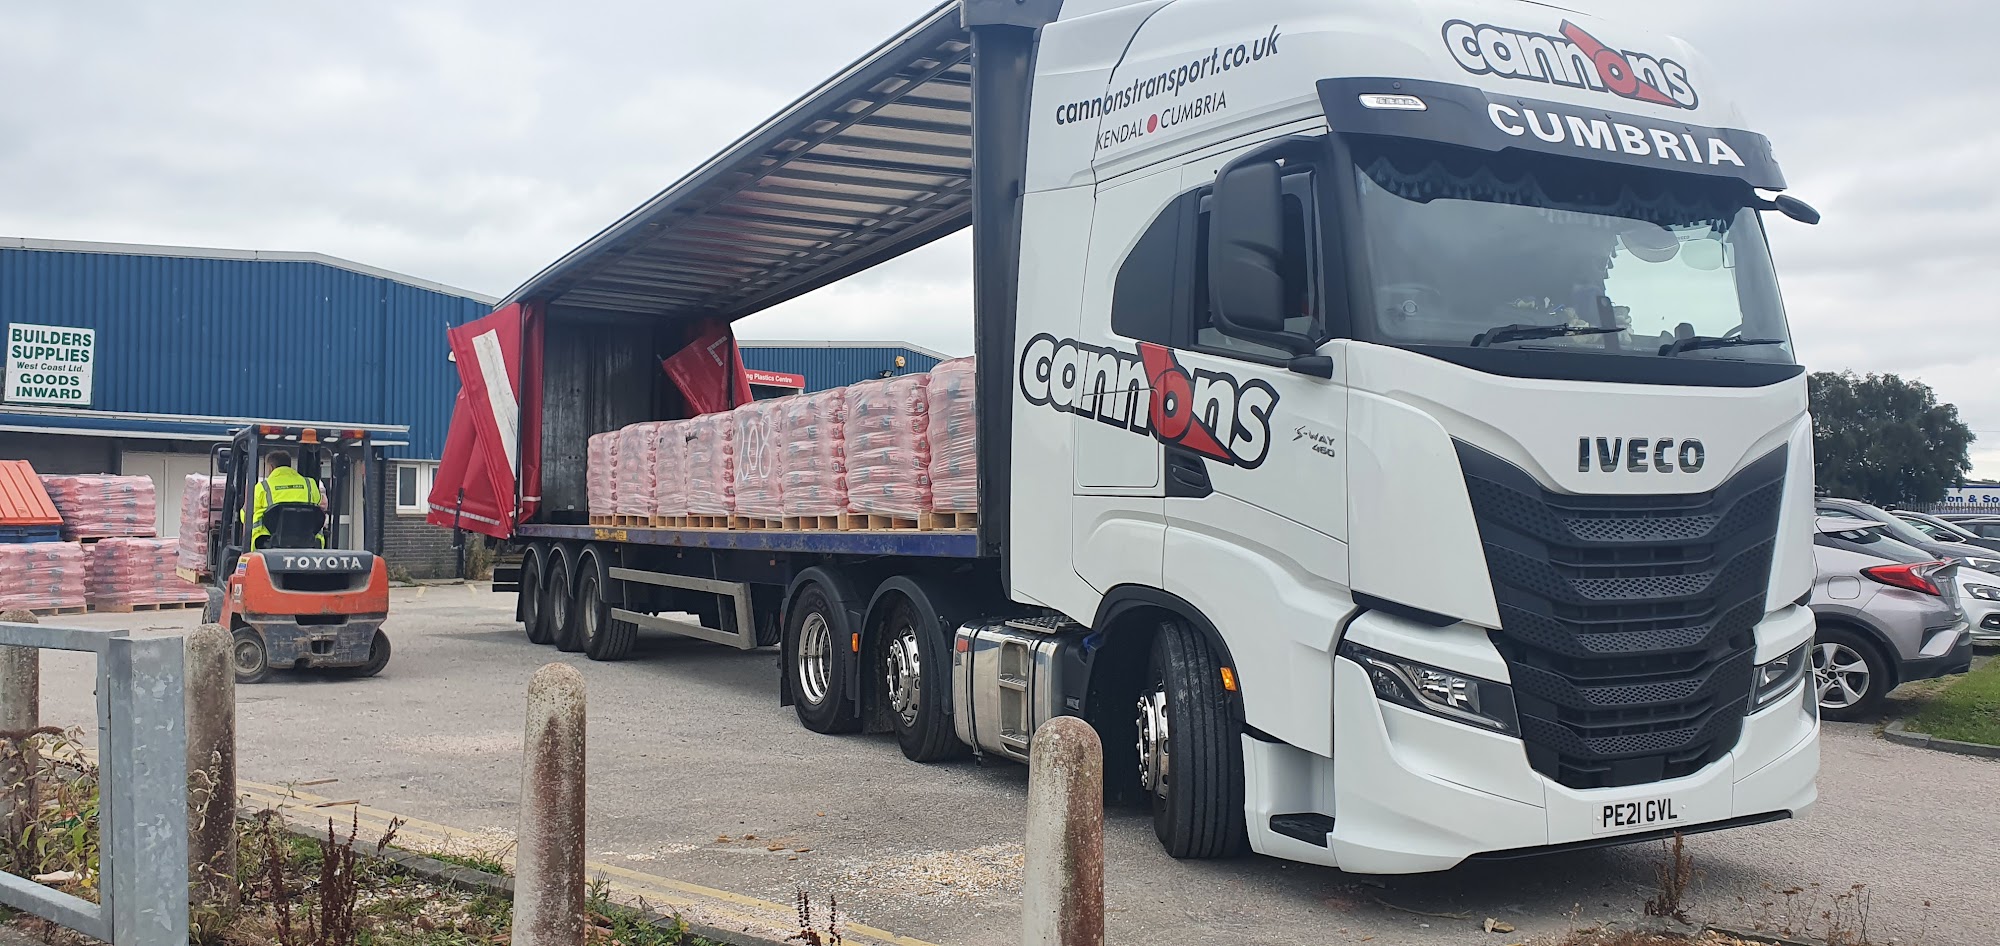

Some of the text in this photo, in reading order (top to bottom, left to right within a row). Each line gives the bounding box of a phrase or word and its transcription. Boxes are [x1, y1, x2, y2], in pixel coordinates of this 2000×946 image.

[1441, 19, 1699, 111] cannons
[1056, 24, 1282, 126] cannonstransport.co.uk
[1095, 90, 1227, 151] KENDAL CUMBRIA
[1487, 102, 1745, 167] CUMBRIA
[12, 328, 92, 347] BUILDERS
[11, 345, 90, 363] SUPPLIES
[16, 361, 84, 373] West Coast Ltd.
[19, 373, 80, 386] GOODS
[754, 373, 775, 382] Plastics
[775, 375, 792, 383] Centre
[15, 386, 82, 399] INWARD
[1019, 332, 1280, 470] cannons
[1292, 425, 1335, 446] S-WAY
[1311, 443, 1335, 458] 460
[1578, 436, 1705, 473] IVECO
[1968, 494, 1977, 503] &
[283, 556, 363, 569] TOYOTA
[1603, 798, 1678, 828] PE21 GVL
